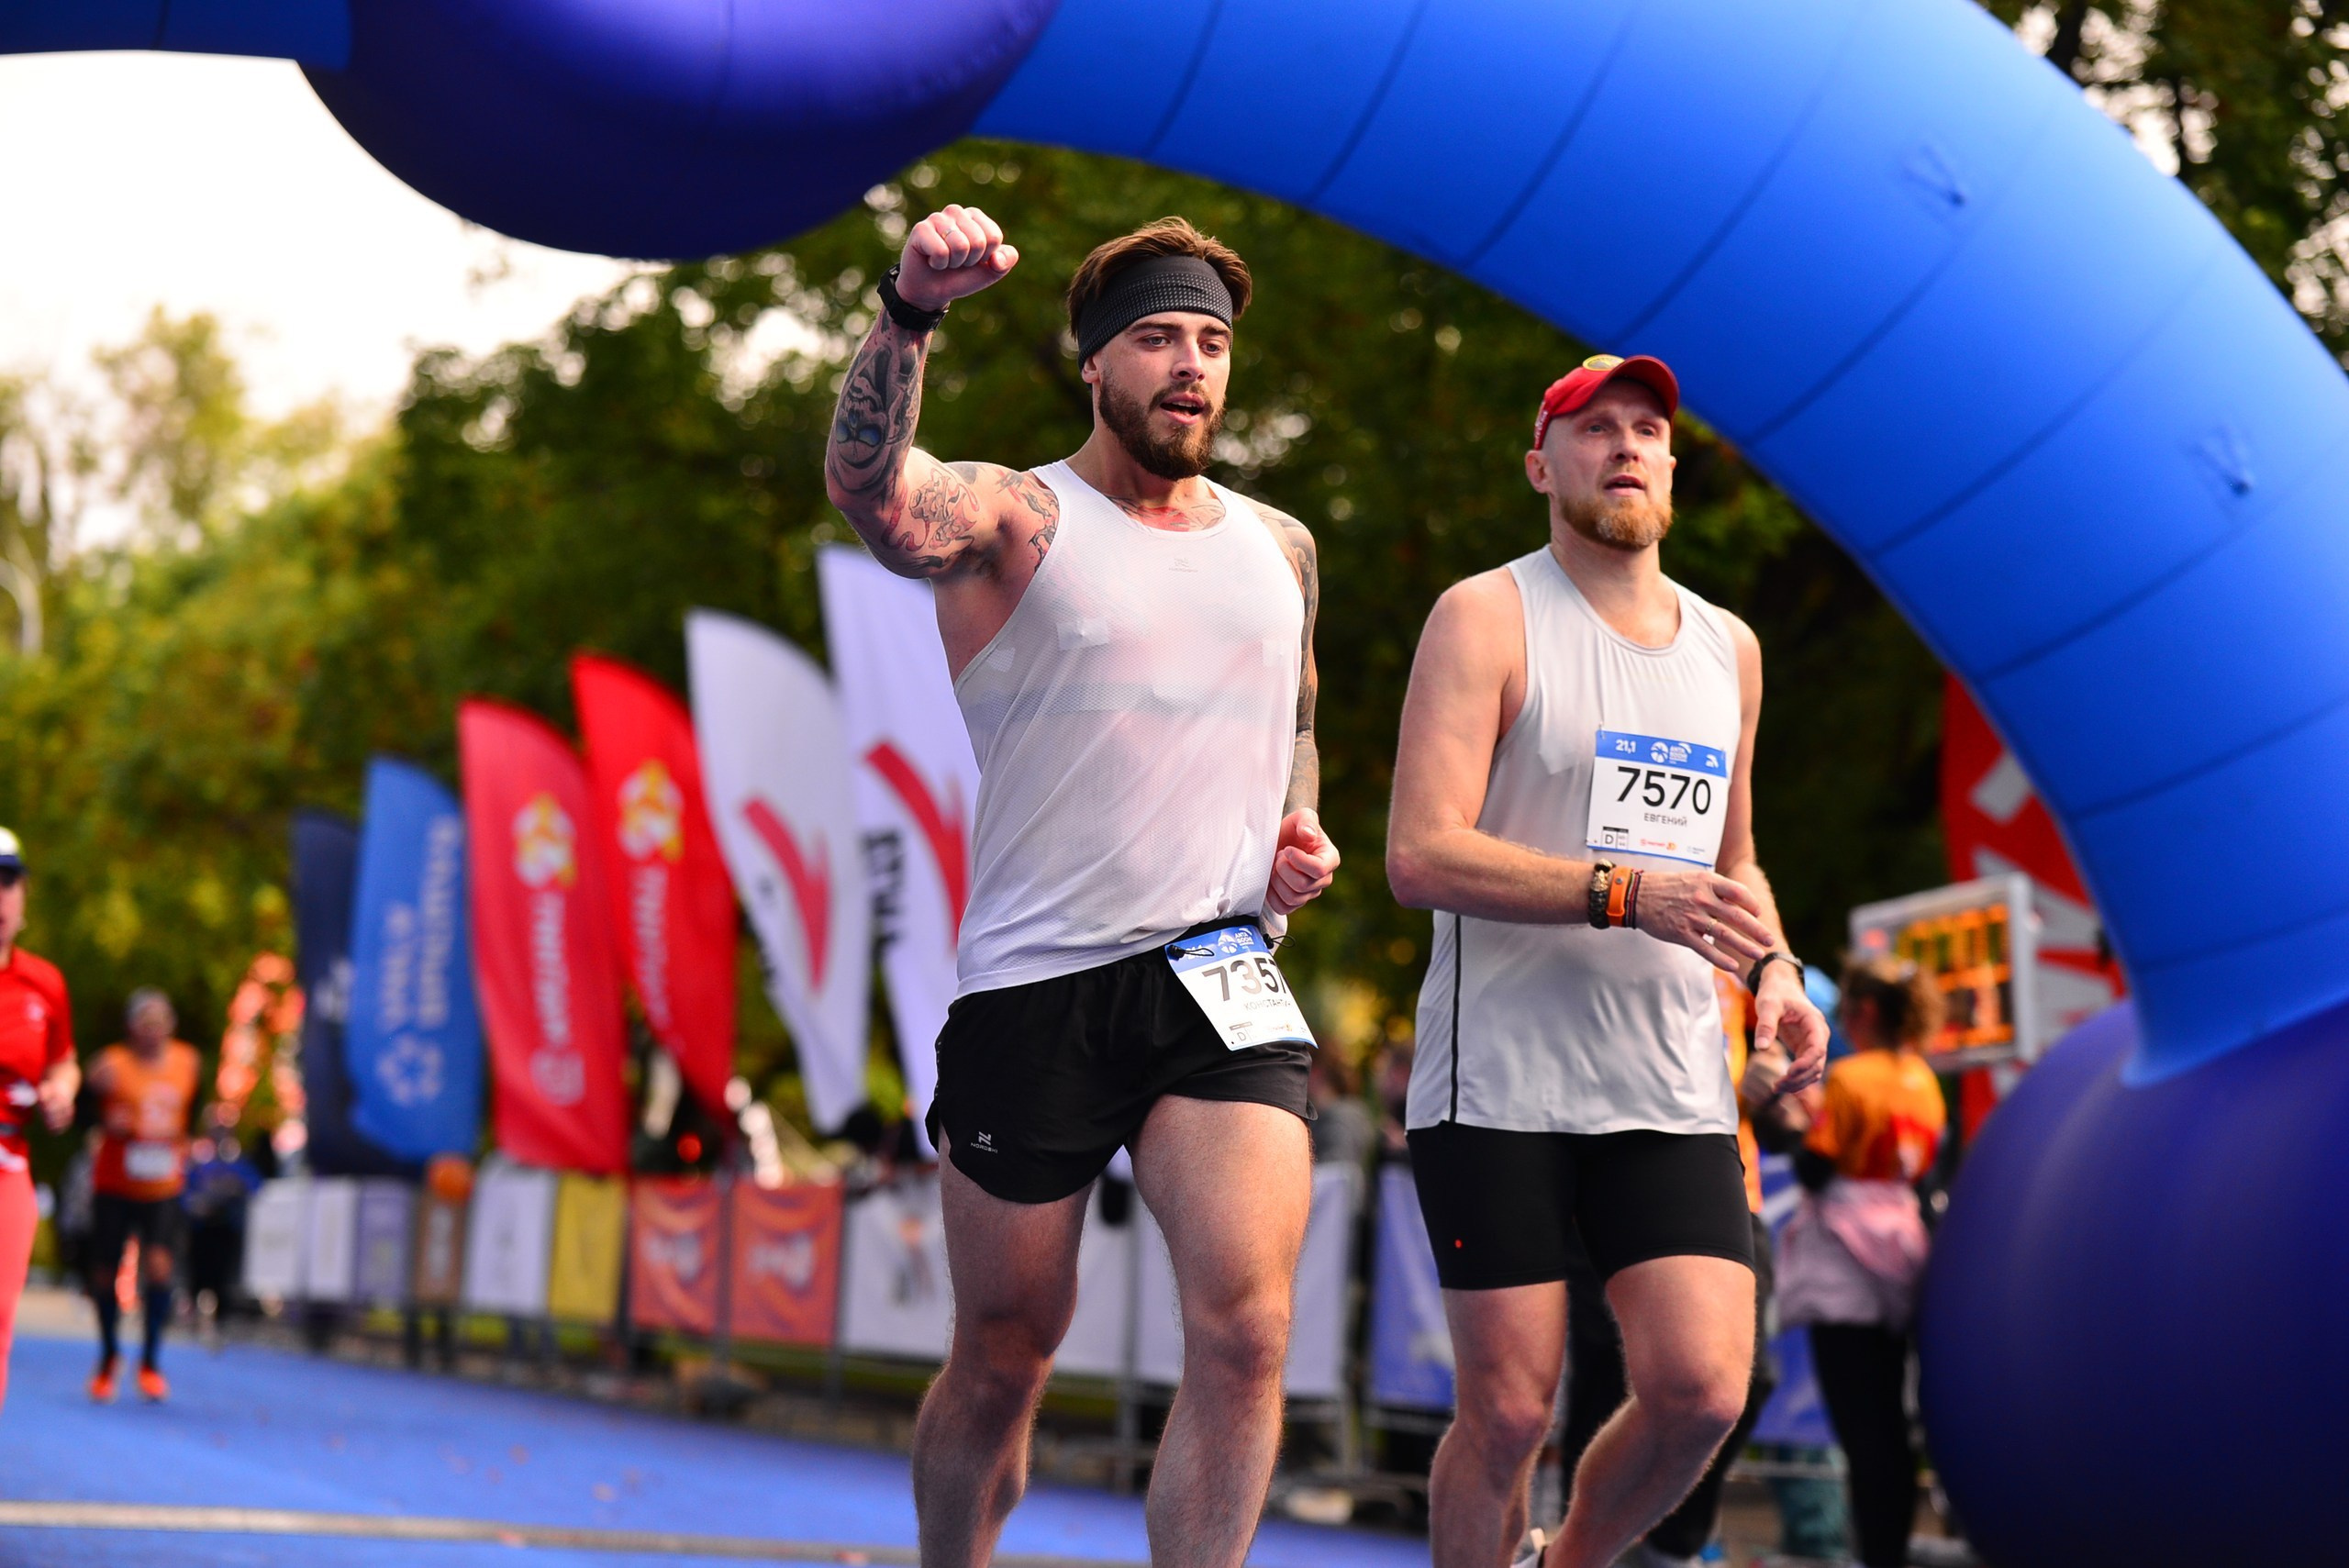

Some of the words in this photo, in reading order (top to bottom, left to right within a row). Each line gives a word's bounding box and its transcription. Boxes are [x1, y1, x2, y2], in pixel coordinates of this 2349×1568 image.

[1615, 739, 1636, 753] 21,1
[1617, 766, 1711, 815] 7570
[1643, 812, 1687, 827] ЕВГЕНИЙ
[1605, 833, 1614, 844] D
